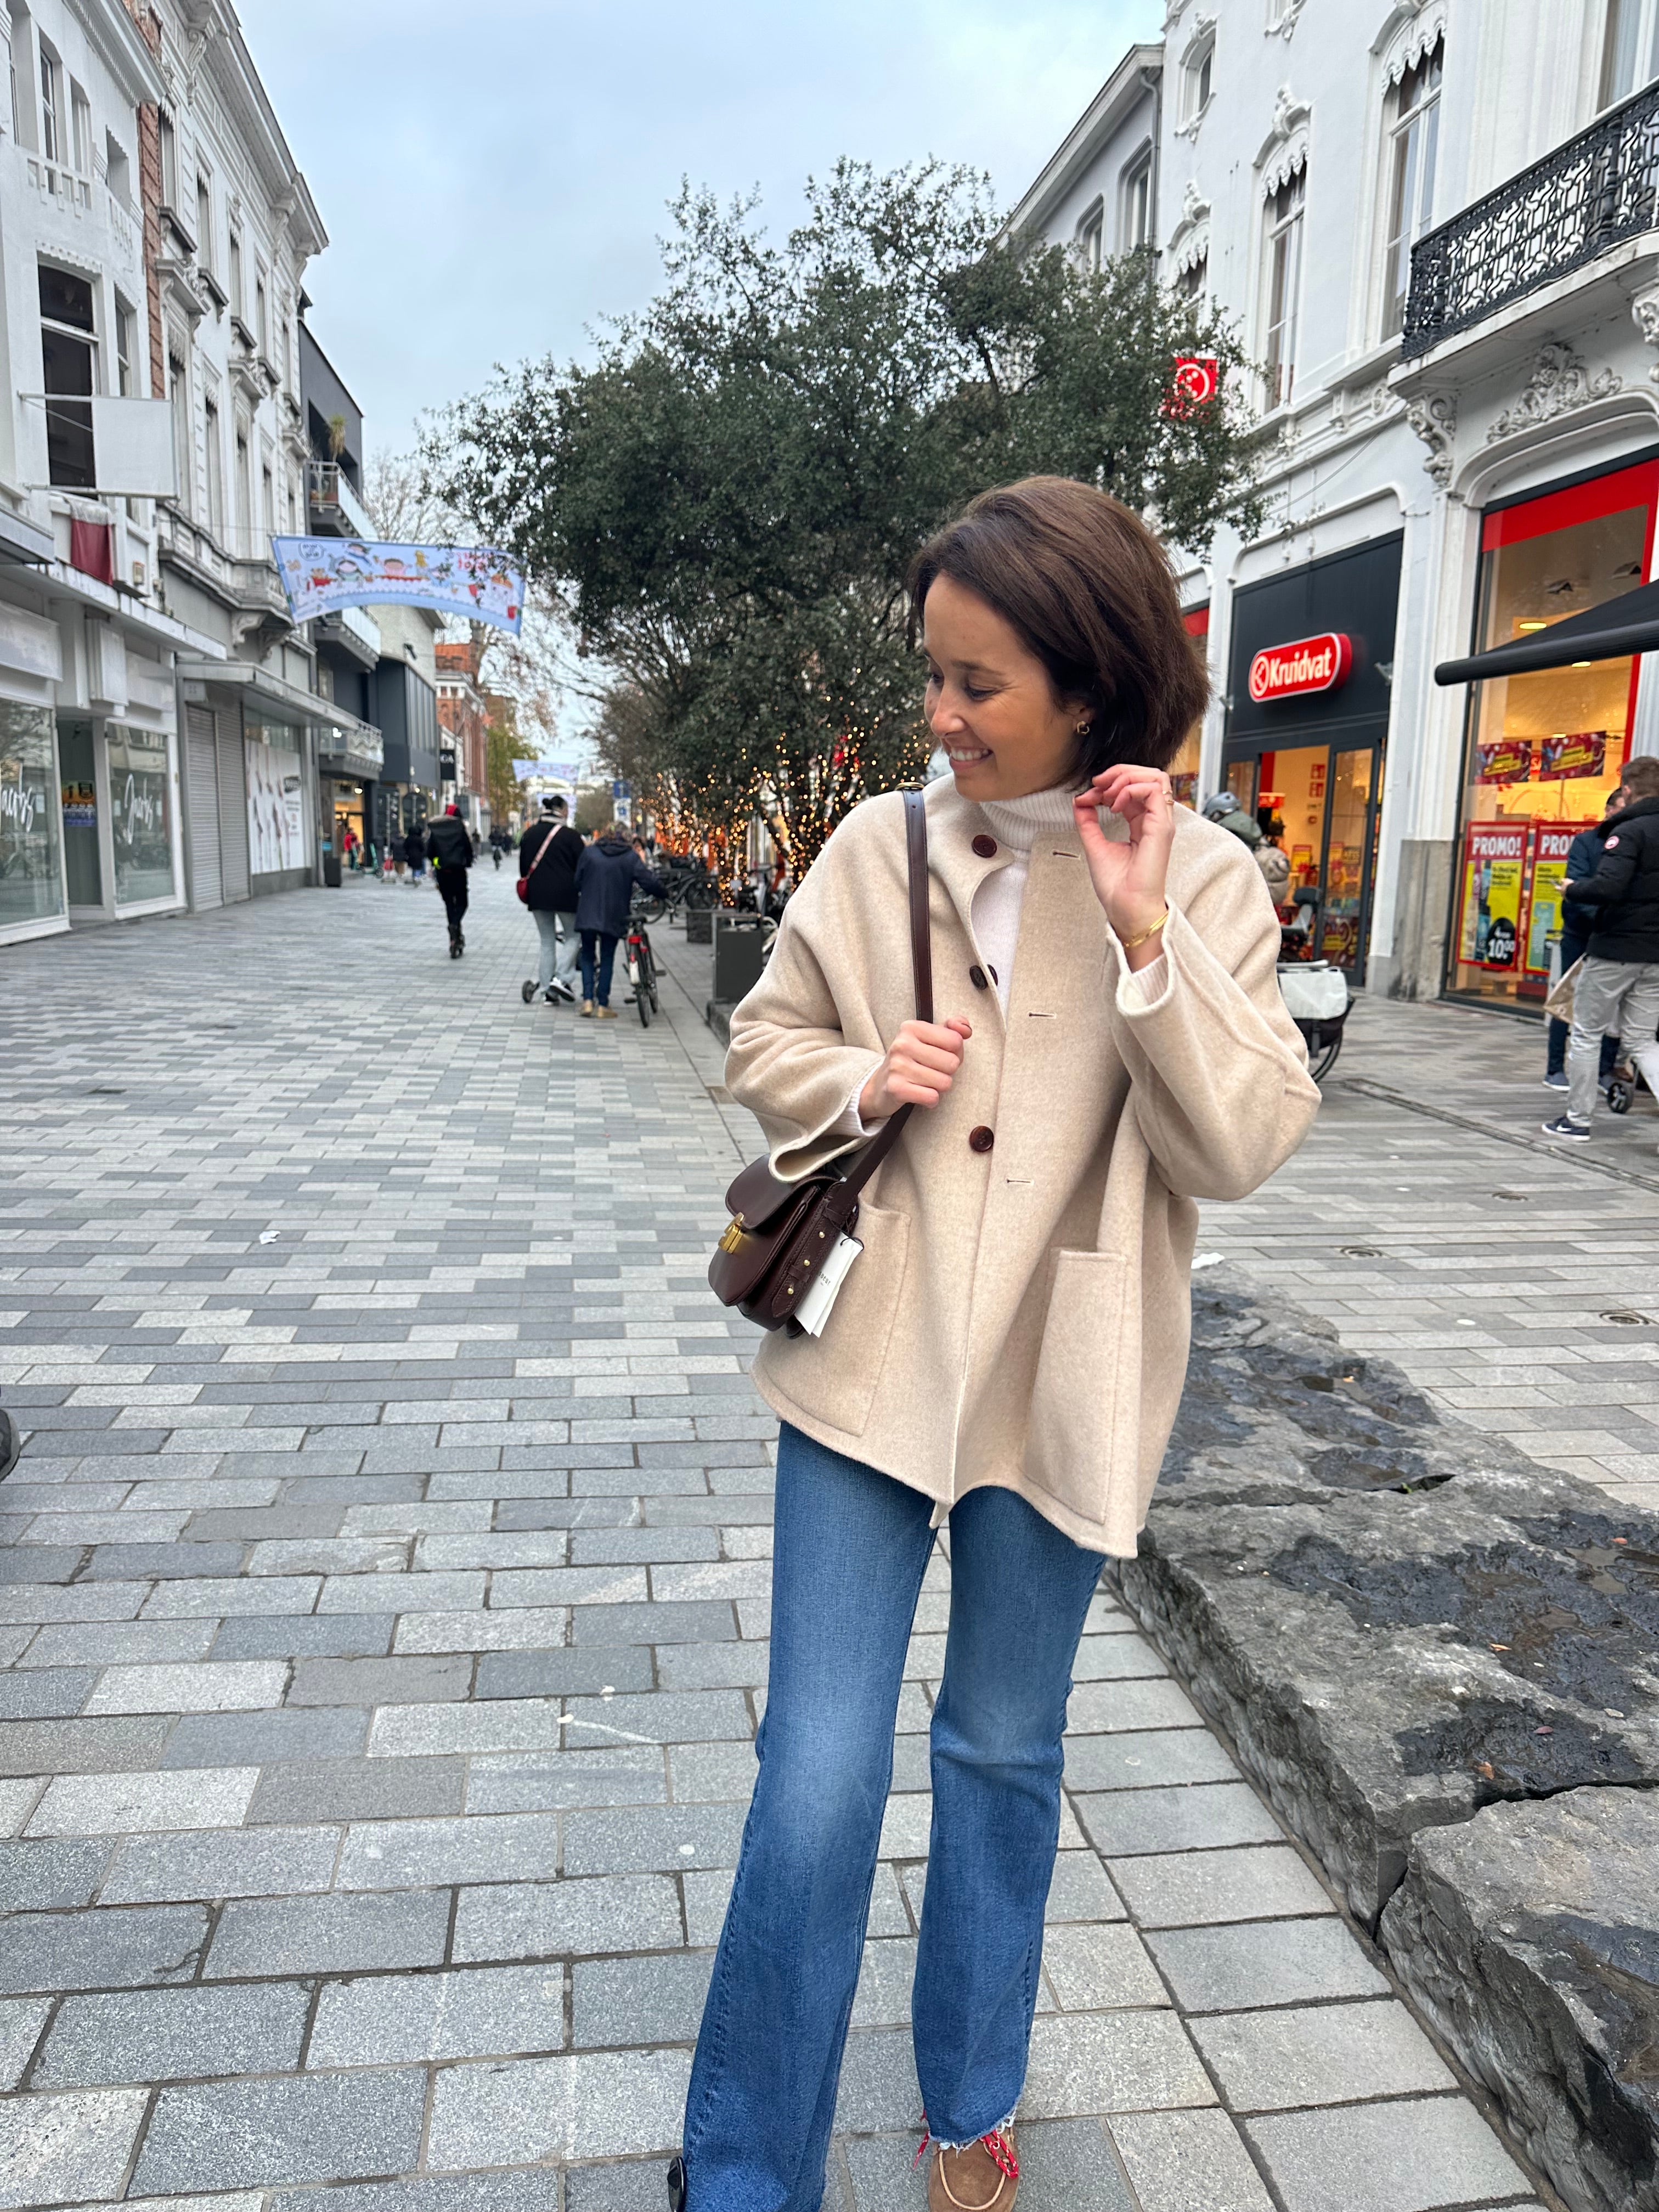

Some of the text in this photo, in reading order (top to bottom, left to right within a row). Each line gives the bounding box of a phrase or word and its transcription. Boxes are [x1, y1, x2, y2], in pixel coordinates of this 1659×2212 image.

[1268, 646, 1332, 688] Kruidvat
[1471, 836, 1522, 857] PROMO!
[1541, 834, 1575, 855] PRO
[818, 1271, 831, 1285] soeur
